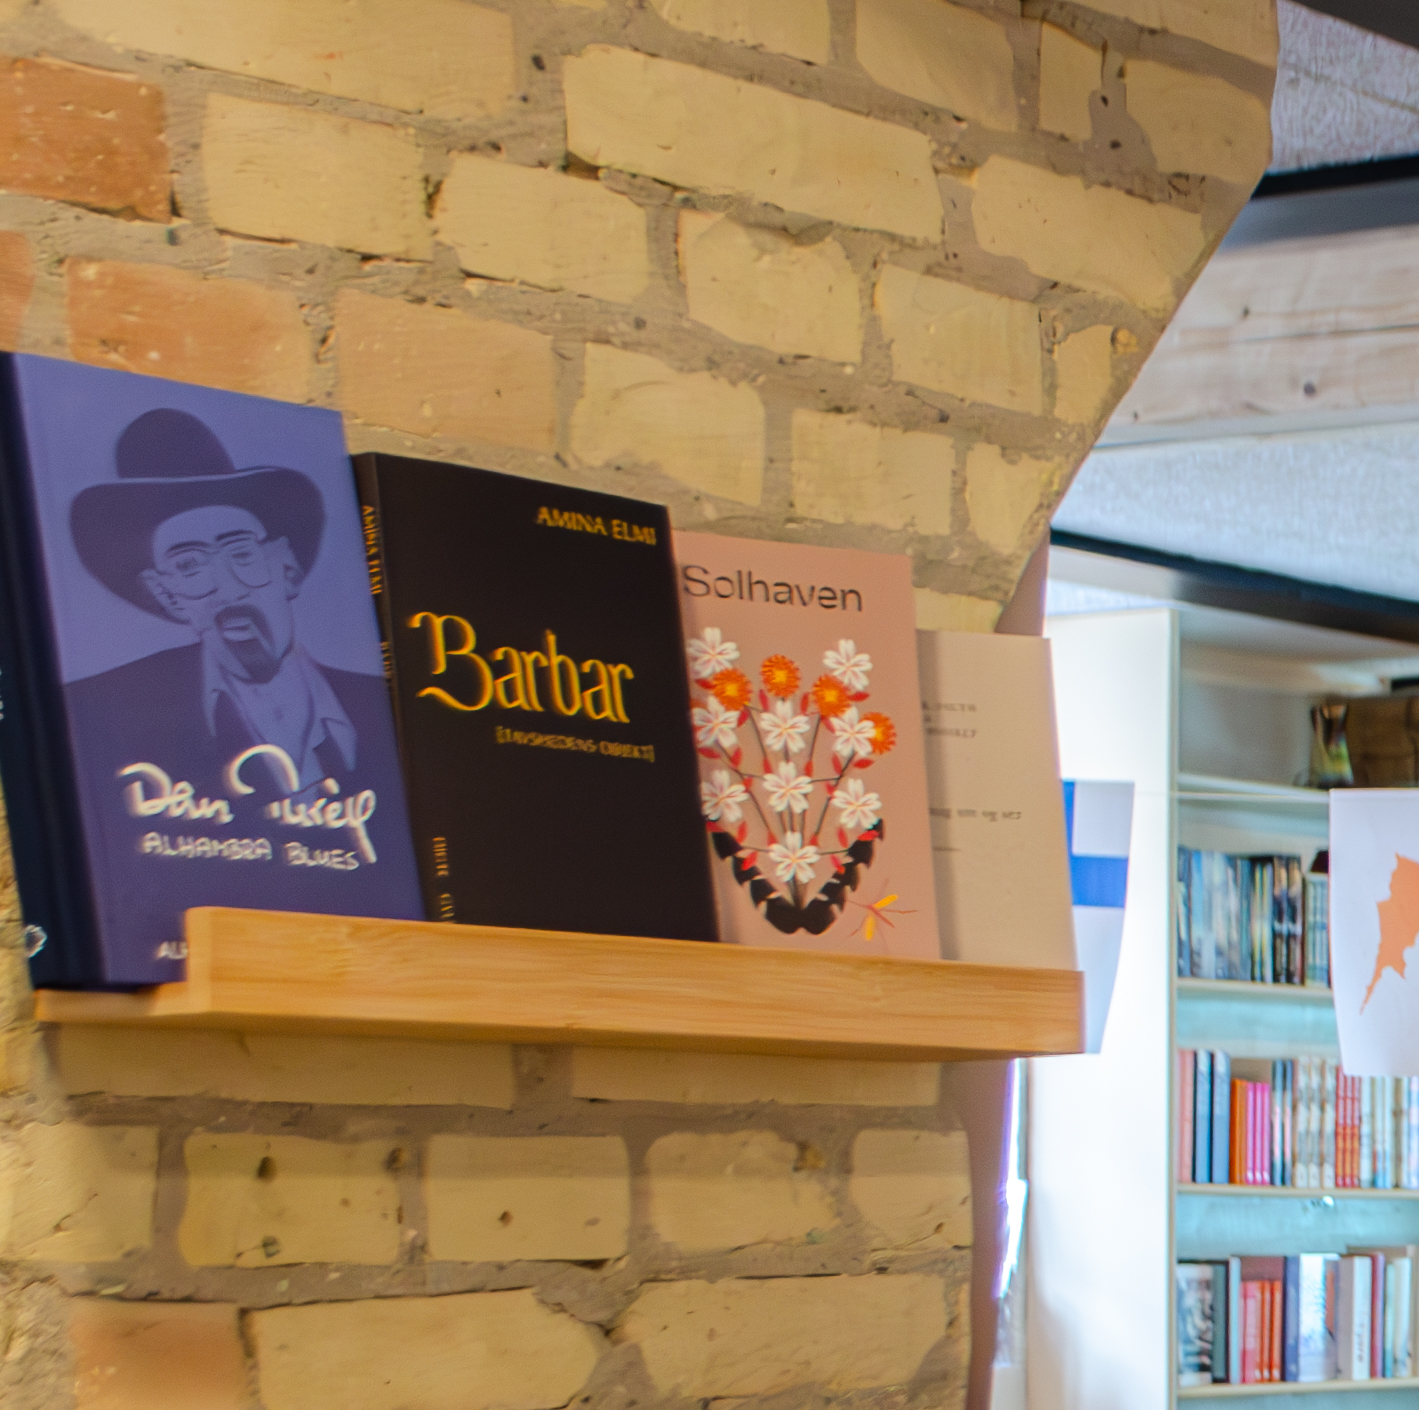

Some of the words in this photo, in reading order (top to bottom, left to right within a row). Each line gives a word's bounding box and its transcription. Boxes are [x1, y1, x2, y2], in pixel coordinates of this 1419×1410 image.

[536, 506, 608, 536] AMINA
[612, 519, 657, 546] ELMI
[682, 564, 864, 612] Solhaven
[407, 611, 635, 723] Barbar
[117, 762, 235, 825] Dan
[141, 831, 274, 861] ALHAMBRA
[283, 841, 360, 871] BLUES
